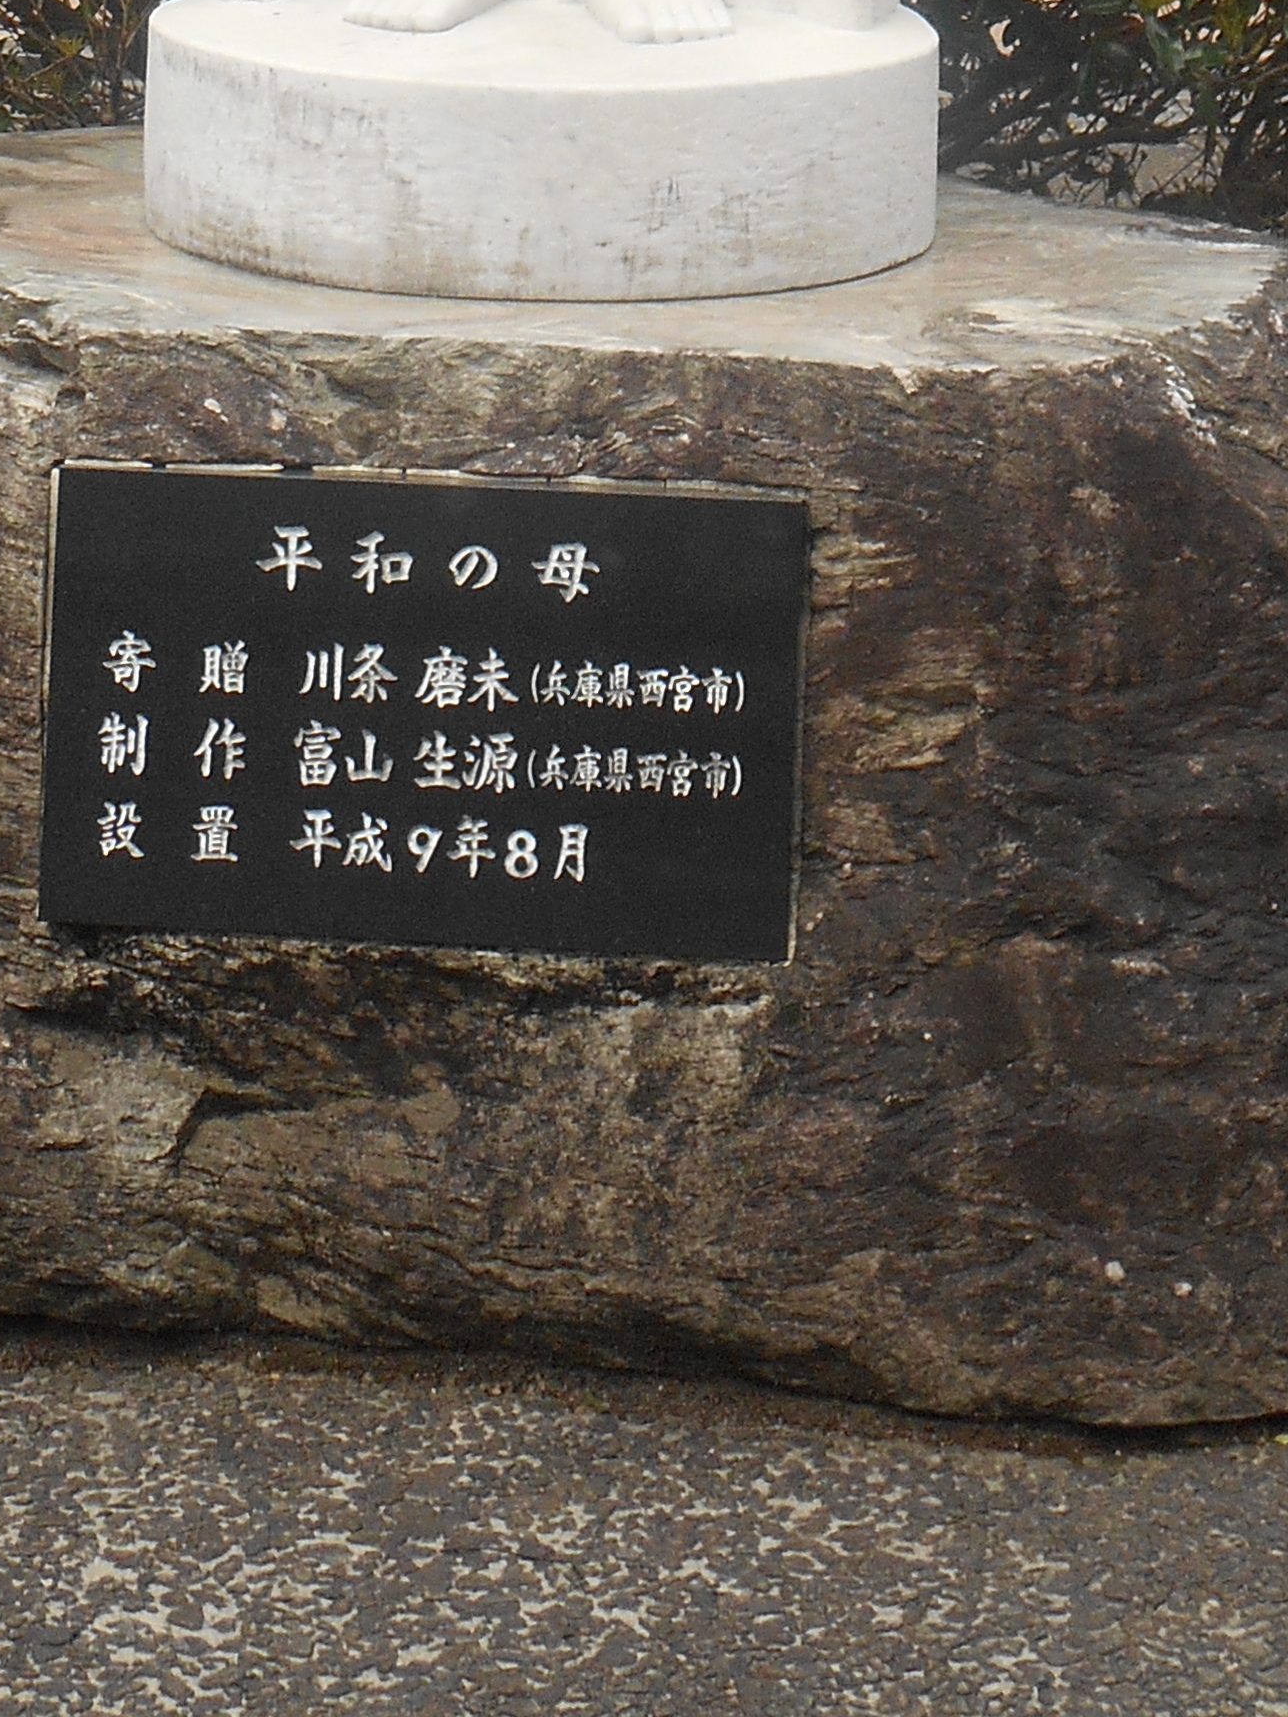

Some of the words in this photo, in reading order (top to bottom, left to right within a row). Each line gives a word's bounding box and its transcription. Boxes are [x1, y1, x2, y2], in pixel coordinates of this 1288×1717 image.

[255, 525, 600, 603] 平和の母
[102, 630, 249, 694] 寄贈
[97, 711, 247, 780] 制作
[96, 802, 238, 862] 設置
[289, 809, 589, 882] 平成9年8月
